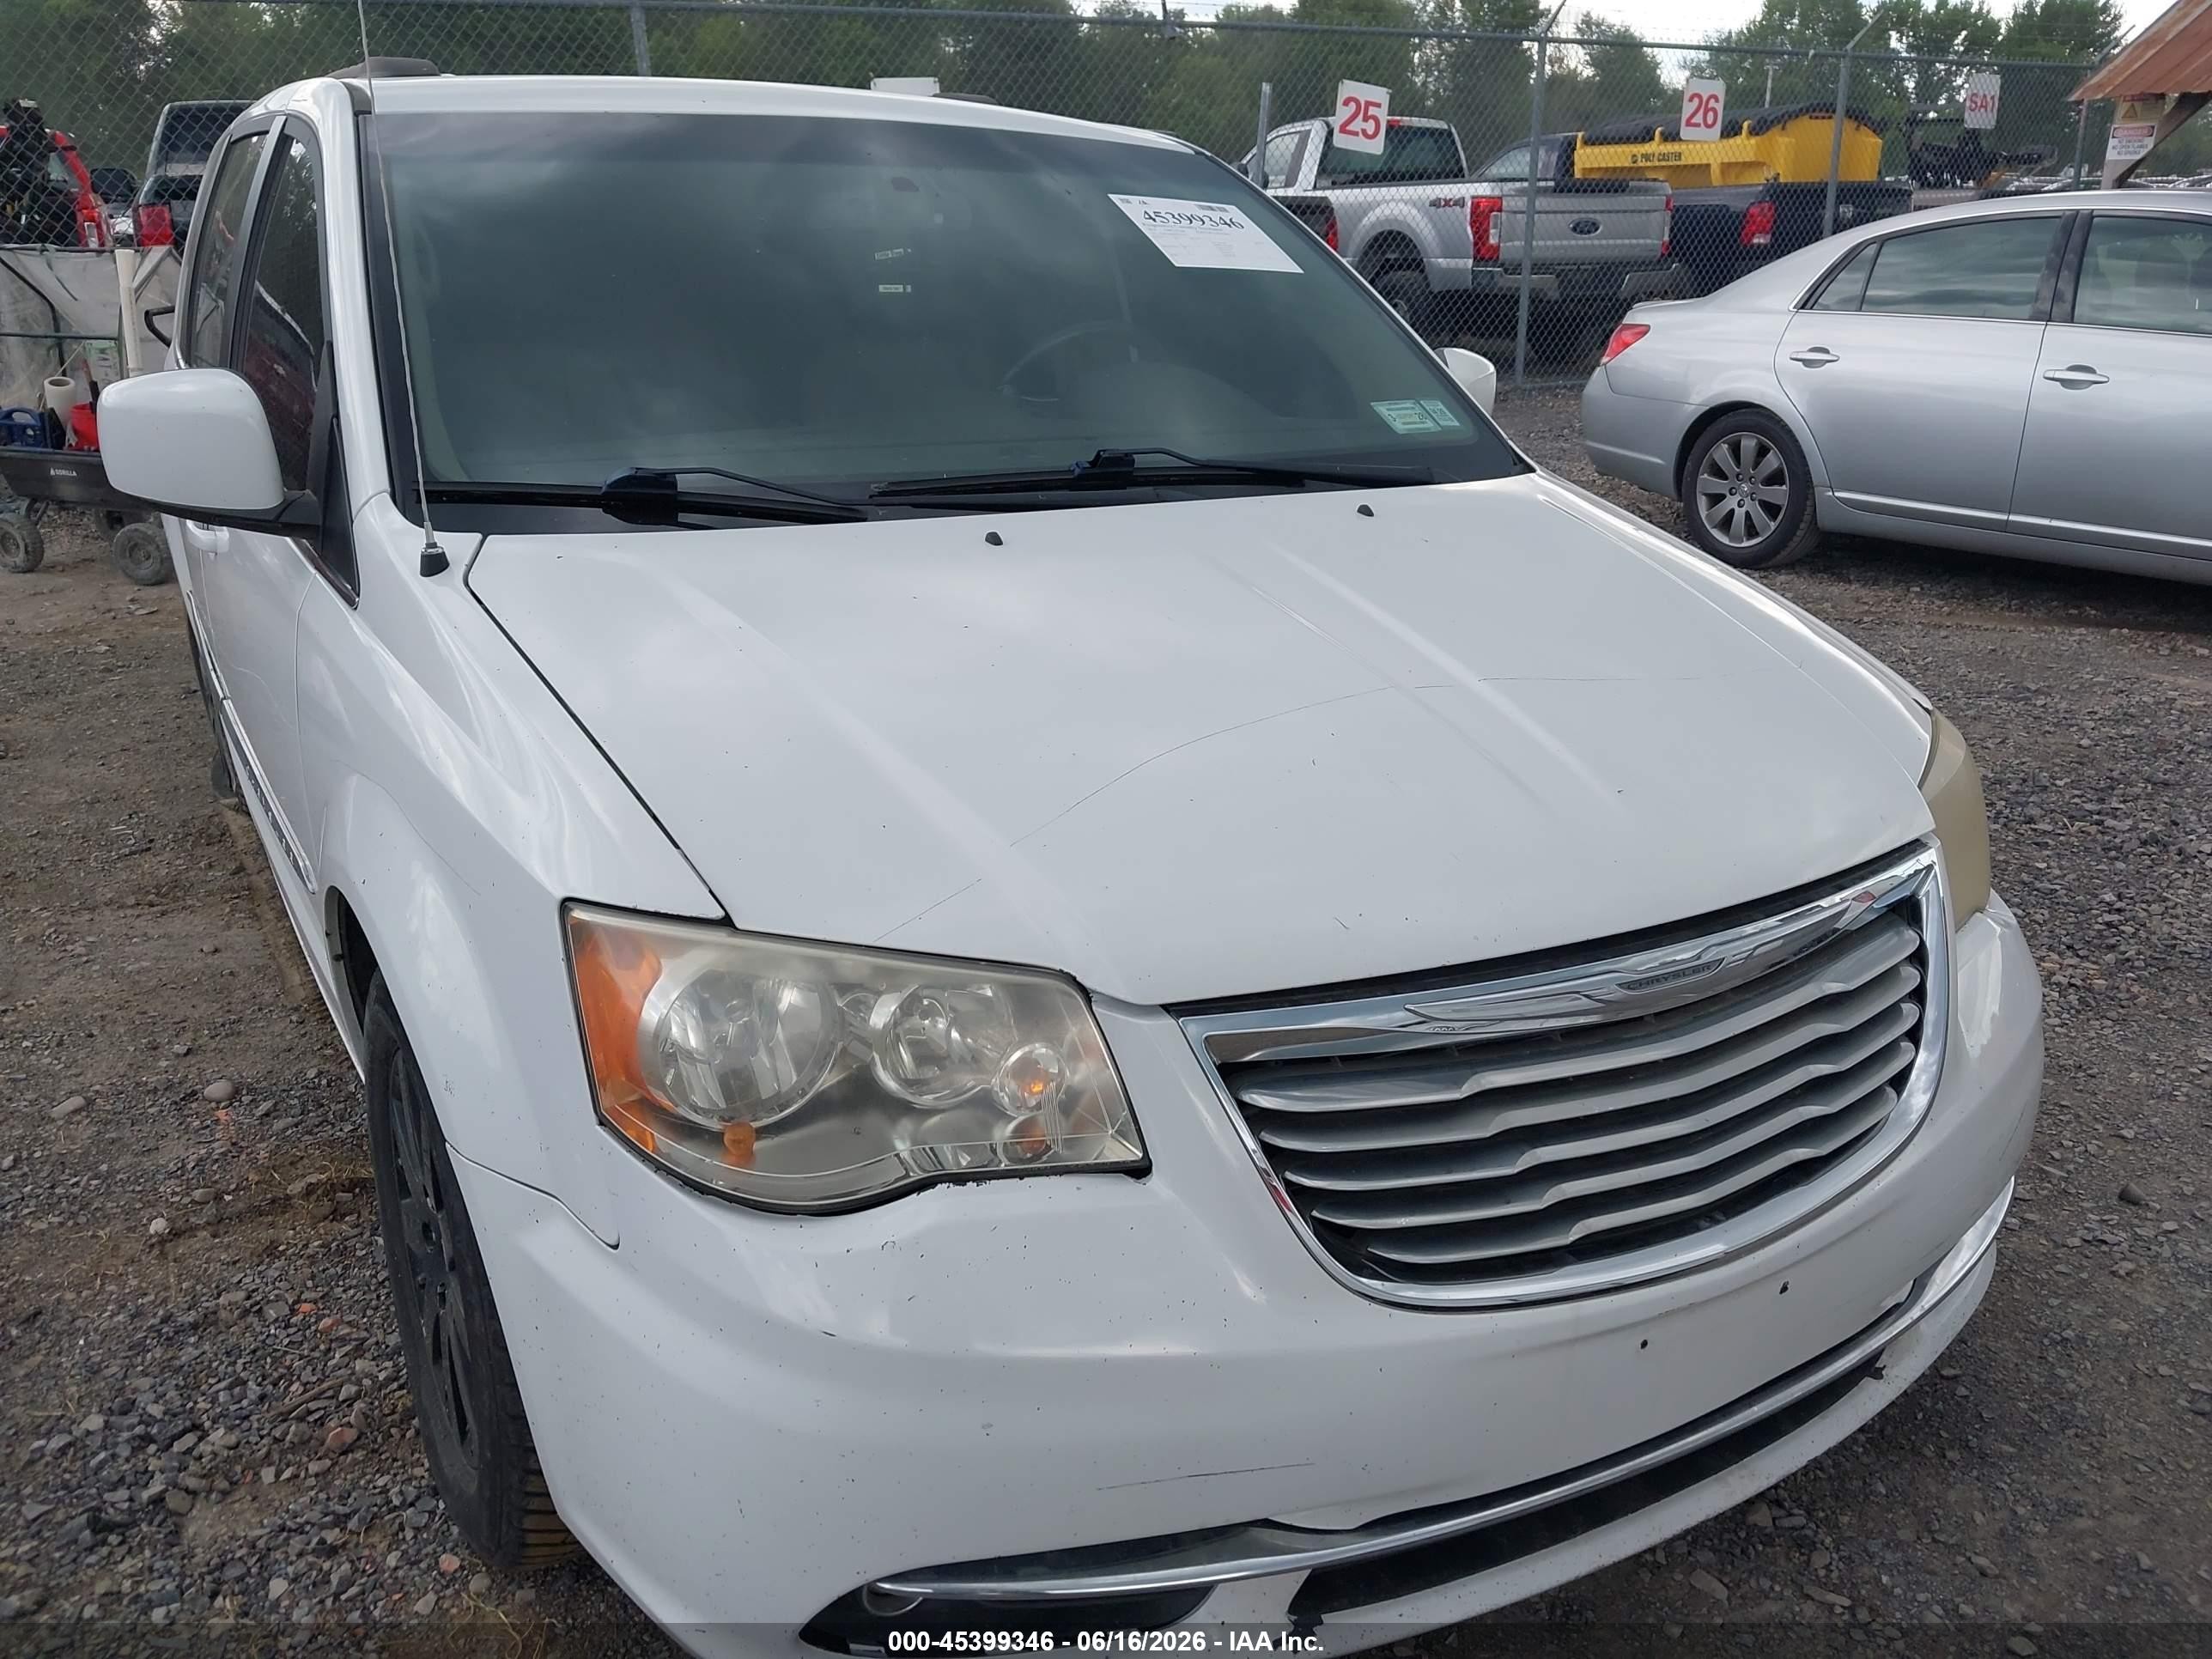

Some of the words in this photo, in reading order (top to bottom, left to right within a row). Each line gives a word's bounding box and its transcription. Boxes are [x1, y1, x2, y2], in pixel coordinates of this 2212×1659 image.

[1685, 92, 1719, 129] 26
[1969, 93, 1995, 113] SA1
[1338, 96, 1382, 140] 25
[1143, 210, 1245, 230] 45399346
[1627, 963, 1712, 990] CHRYSLER
